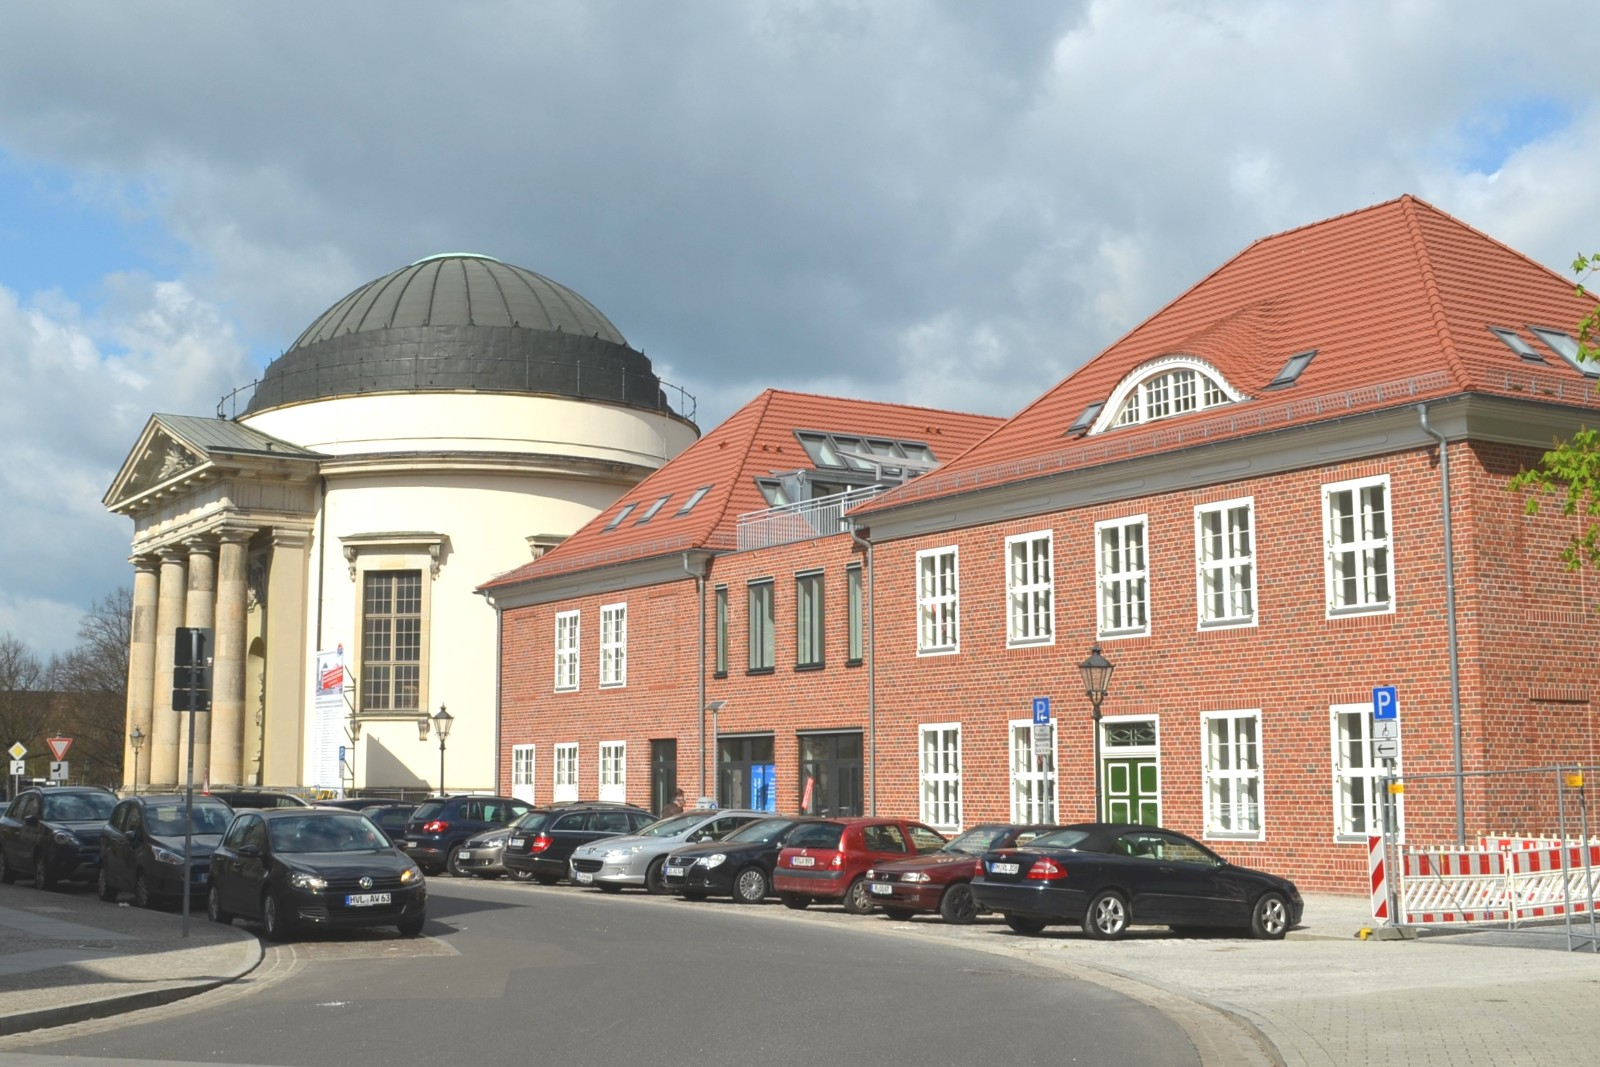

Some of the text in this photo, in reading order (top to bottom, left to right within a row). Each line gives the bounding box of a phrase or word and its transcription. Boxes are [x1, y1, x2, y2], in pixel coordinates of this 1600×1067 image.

[1036, 701, 1046, 722] P
[1378, 691, 1391, 716] P
[350, 894, 390, 904] HVL AW 63
